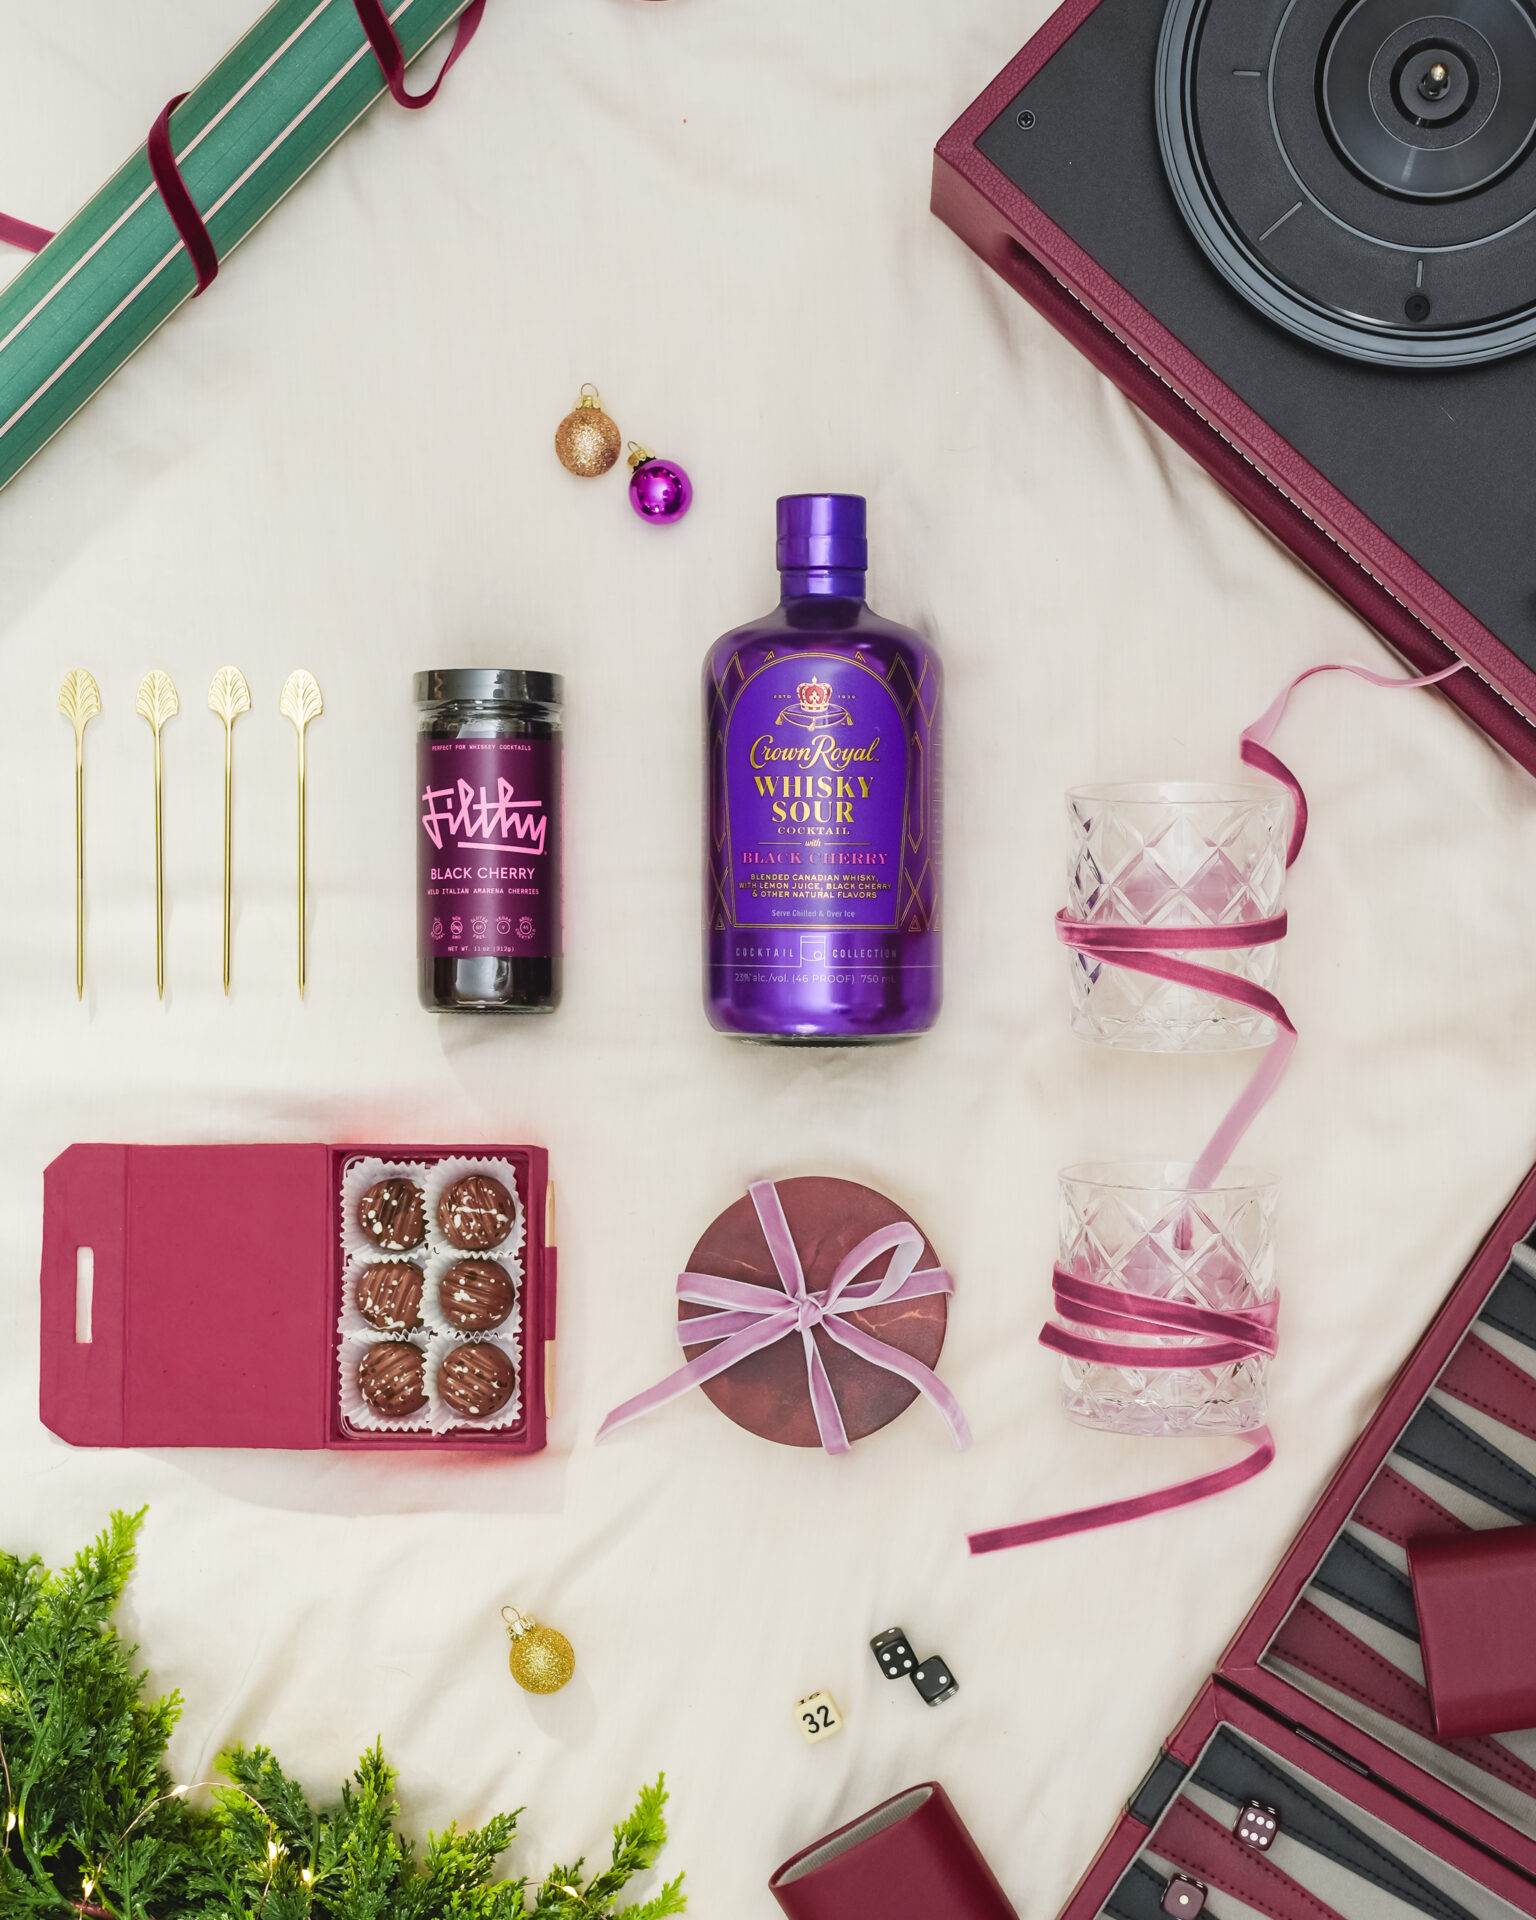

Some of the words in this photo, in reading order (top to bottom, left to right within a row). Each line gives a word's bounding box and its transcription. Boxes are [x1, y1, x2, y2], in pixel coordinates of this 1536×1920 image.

[431, 744, 452, 752] PERFECT
[750, 734, 811, 770] Crown
[798, 734, 880, 772] Royal
[753, 775, 874, 799] WHISKY
[421, 777, 547, 856] Filthy
[771, 800, 855, 823] SOUR
[777, 826, 851, 835] COCKTAIL
[804, 838, 822, 847] with
[742, 852, 802, 864] BLACK
[808, 852, 888, 865] CHERRY
[430, 867, 473, 880] BLACK
[476, 867, 536, 880] CHERRY
[750, 873, 790, 881] BLENDED
[792, 874, 840, 882] CANADIAN
[427, 888, 440, 896] WILD
[442, 887, 470, 895] ITALIAN
[473, 887, 504, 895] AMARENA
[507, 887, 540, 896] CHERRIES
[738, 882, 757, 890] WITH
[759, 882, 789, 890] LEMON
[791, 882, 824, 891] JUICE,
[825, 883, 856, 891] BLACK
[858, 883, 893, 891] CHERRY
[751, 889, 759, 898] &
[760, 890, 790, 899] OTHER
[792, 890, 835, 899] NATURAL
[837, 891, 878, 900] FLAVORS
[771, 909, 790, 918] Serve
[792, 909, 817, 918] Chilled
[818, 909, 825, 918] &
[826, 909, 842, 918] Over
[844, 910, 856, 918] Ice
[735, 947, 795, 958] COCKTAIL
[832, 949, 897, 959] COLLECTION
[812, 974, 855, 985] PROOF)
[860, 975, 880, 984] 750
[802, 1705, 836, 1734] 32
